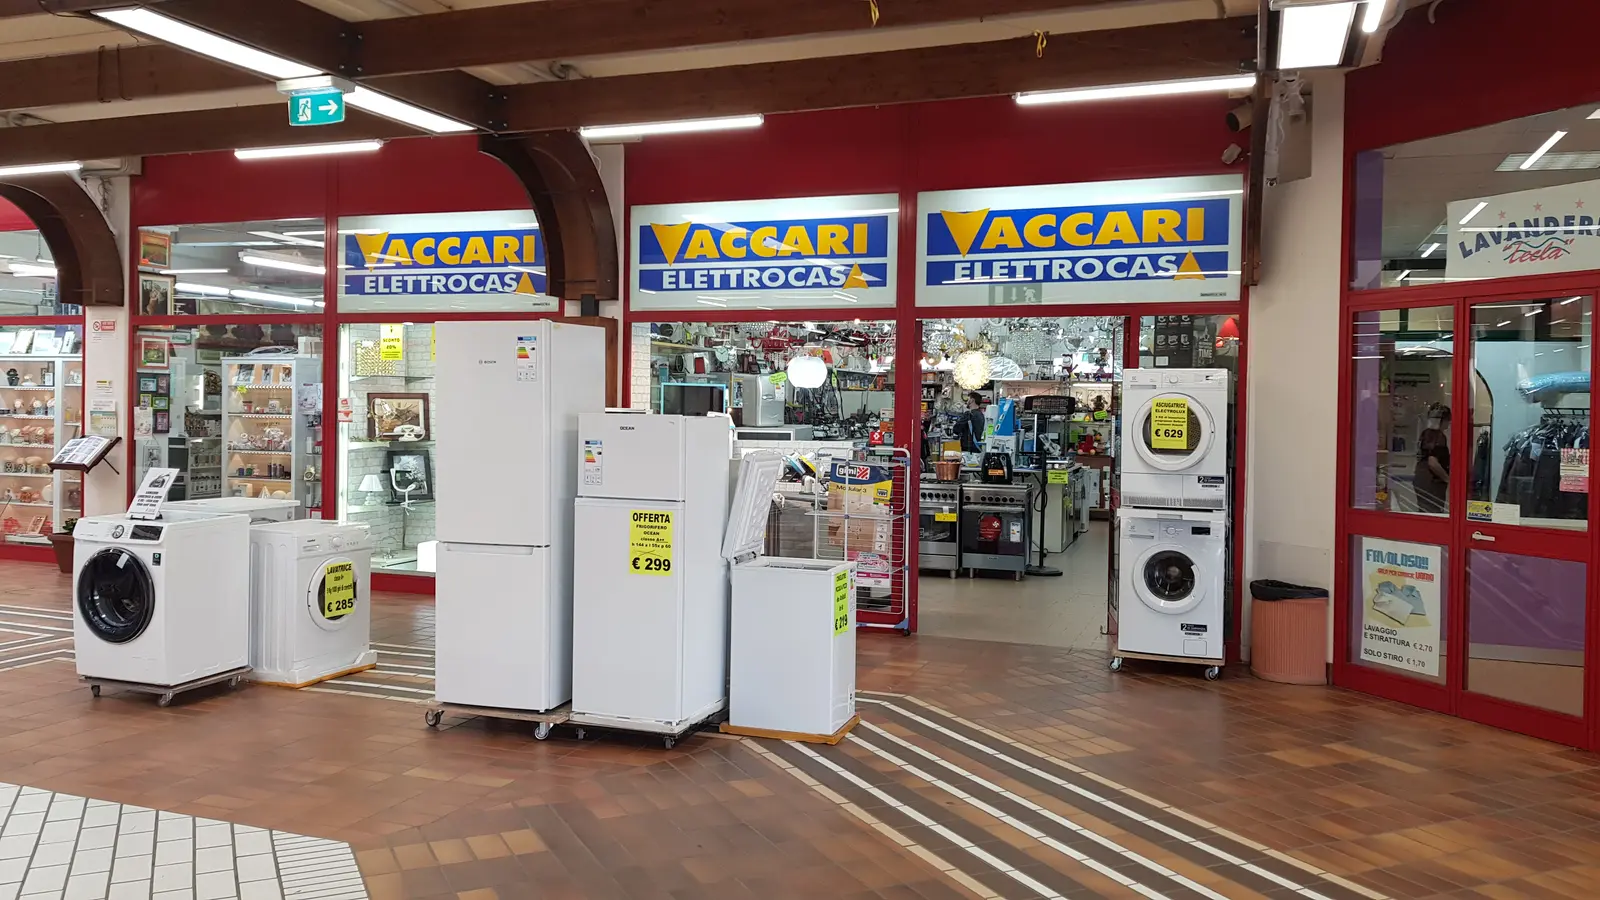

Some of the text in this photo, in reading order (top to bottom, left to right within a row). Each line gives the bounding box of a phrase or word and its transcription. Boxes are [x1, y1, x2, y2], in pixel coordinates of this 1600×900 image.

[939, 207, 1205, 258] VACCARI
[650, 221, 869, 267] VACCARI
[354, 231, 535, 272] VACCARI
[1155, 429, 1183, 439] € 629
[632, 512, 670, 523] OFFERTA
[632, 557, 671, 572] € 299
[327, 598, 354, 612] € 285
[1364, 624, 1397, 636] LAVAGGIO
[1370, 633, 1411, 647] STIRATTURA
[1419, 643, 1433, 652] 2,70
[1364, 648, 1382, 657] SOLO
[1383, 652, 1403, 662] STIRO
